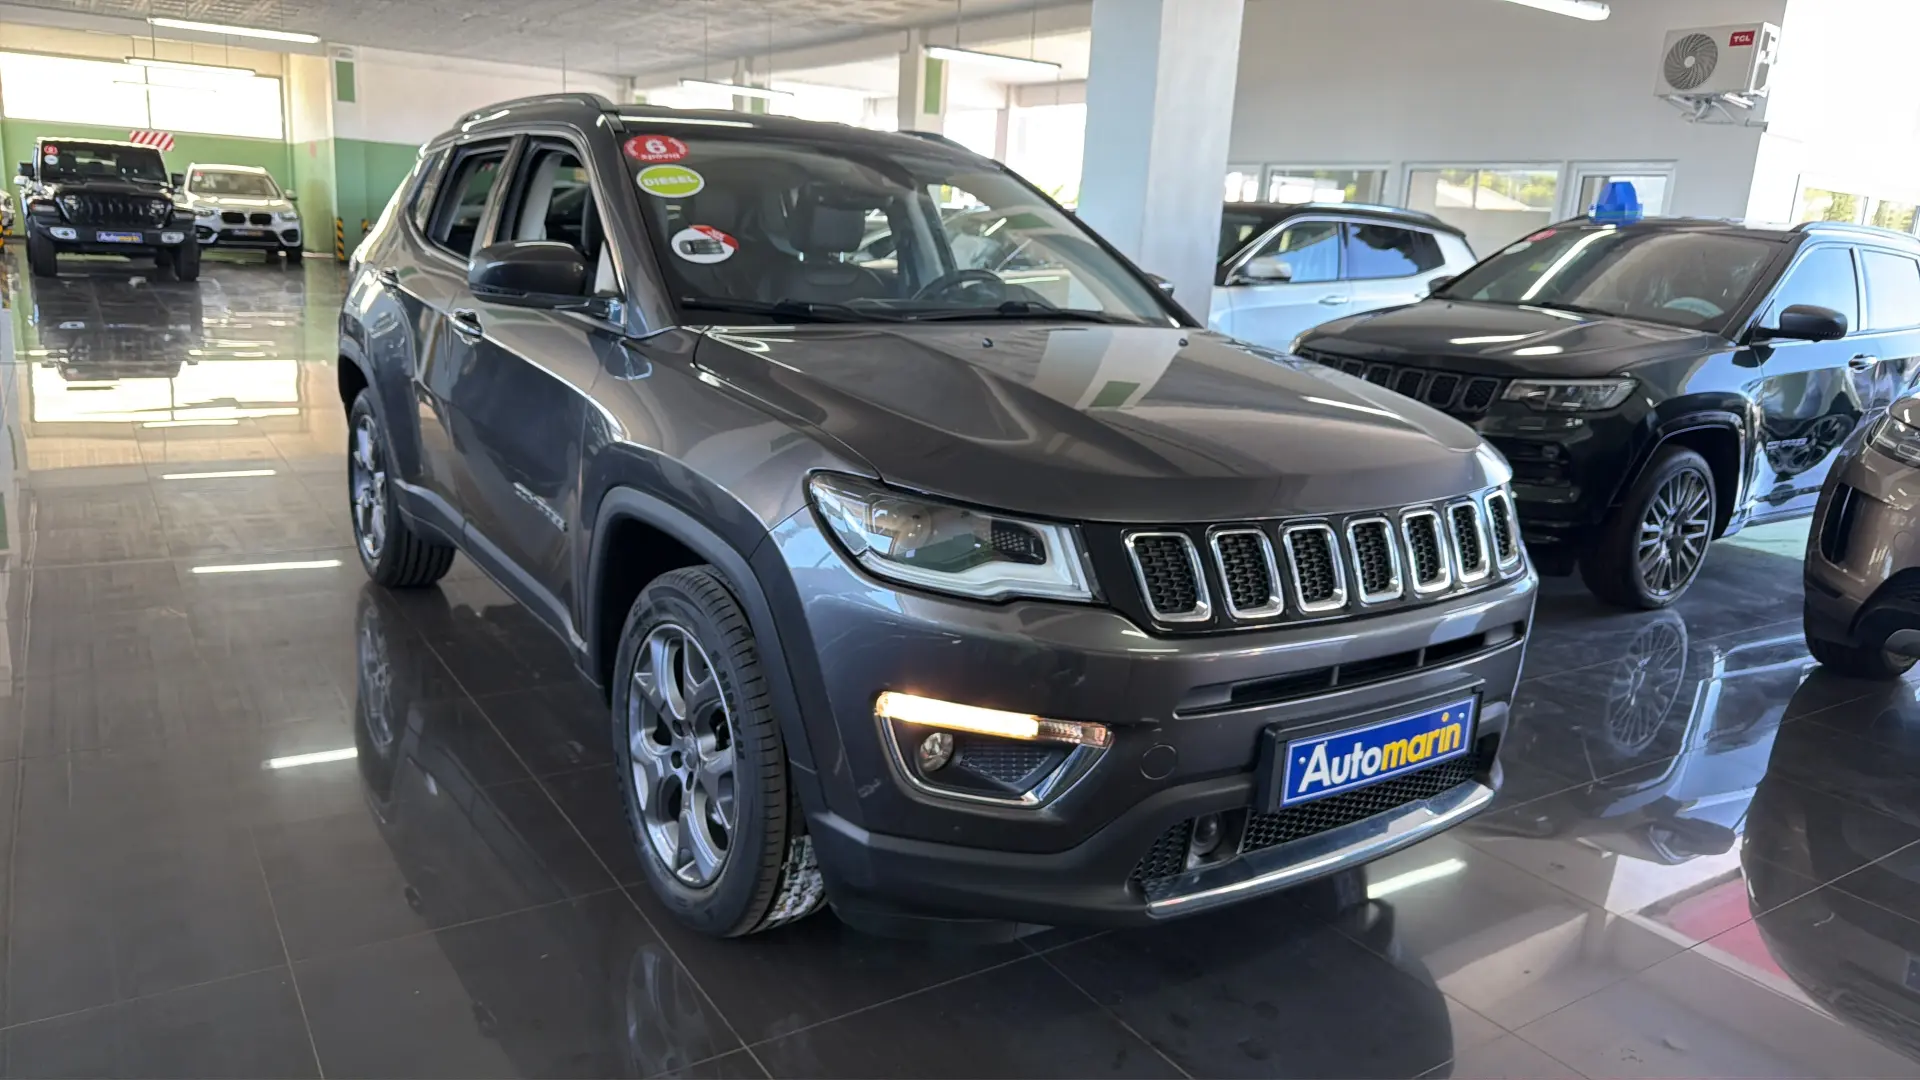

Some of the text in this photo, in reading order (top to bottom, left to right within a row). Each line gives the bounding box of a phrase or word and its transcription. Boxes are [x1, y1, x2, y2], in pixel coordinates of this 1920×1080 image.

[1733, 34, 1751, 43] TCL
[645, 138, 668, 154] 6
[643, 175, 698, 187] DIESEL
[1297, 712, 1462, 793] Automarin
